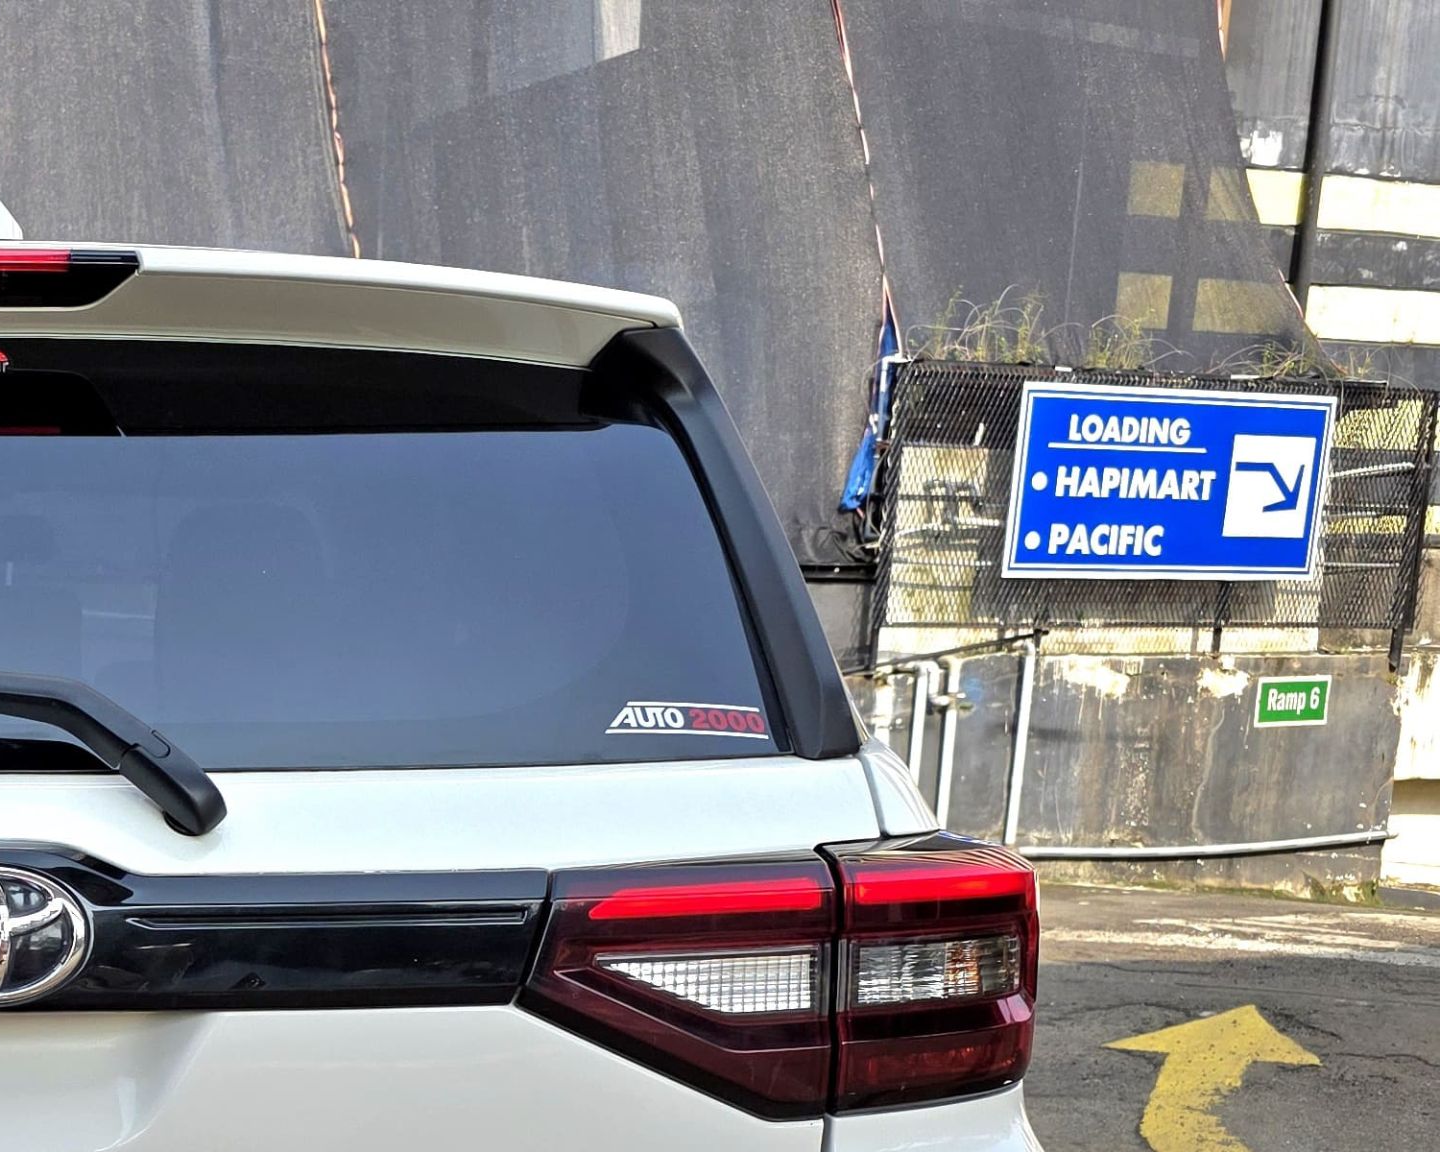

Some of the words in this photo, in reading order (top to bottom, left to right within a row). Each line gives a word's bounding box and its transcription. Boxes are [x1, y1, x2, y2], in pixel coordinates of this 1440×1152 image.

[1068, 413, 1191, 445] LOADING
[1055, 466, 1216, 501] HAPIMART
[1047, 523, 1164, 557] PACIFIC
[1266, 688, 1306, 715] Ramp
[1310, 686, 1320, 710] 6
[610, 706, 685, 729] AUTO
[689, 709, 766, 733] 2000
